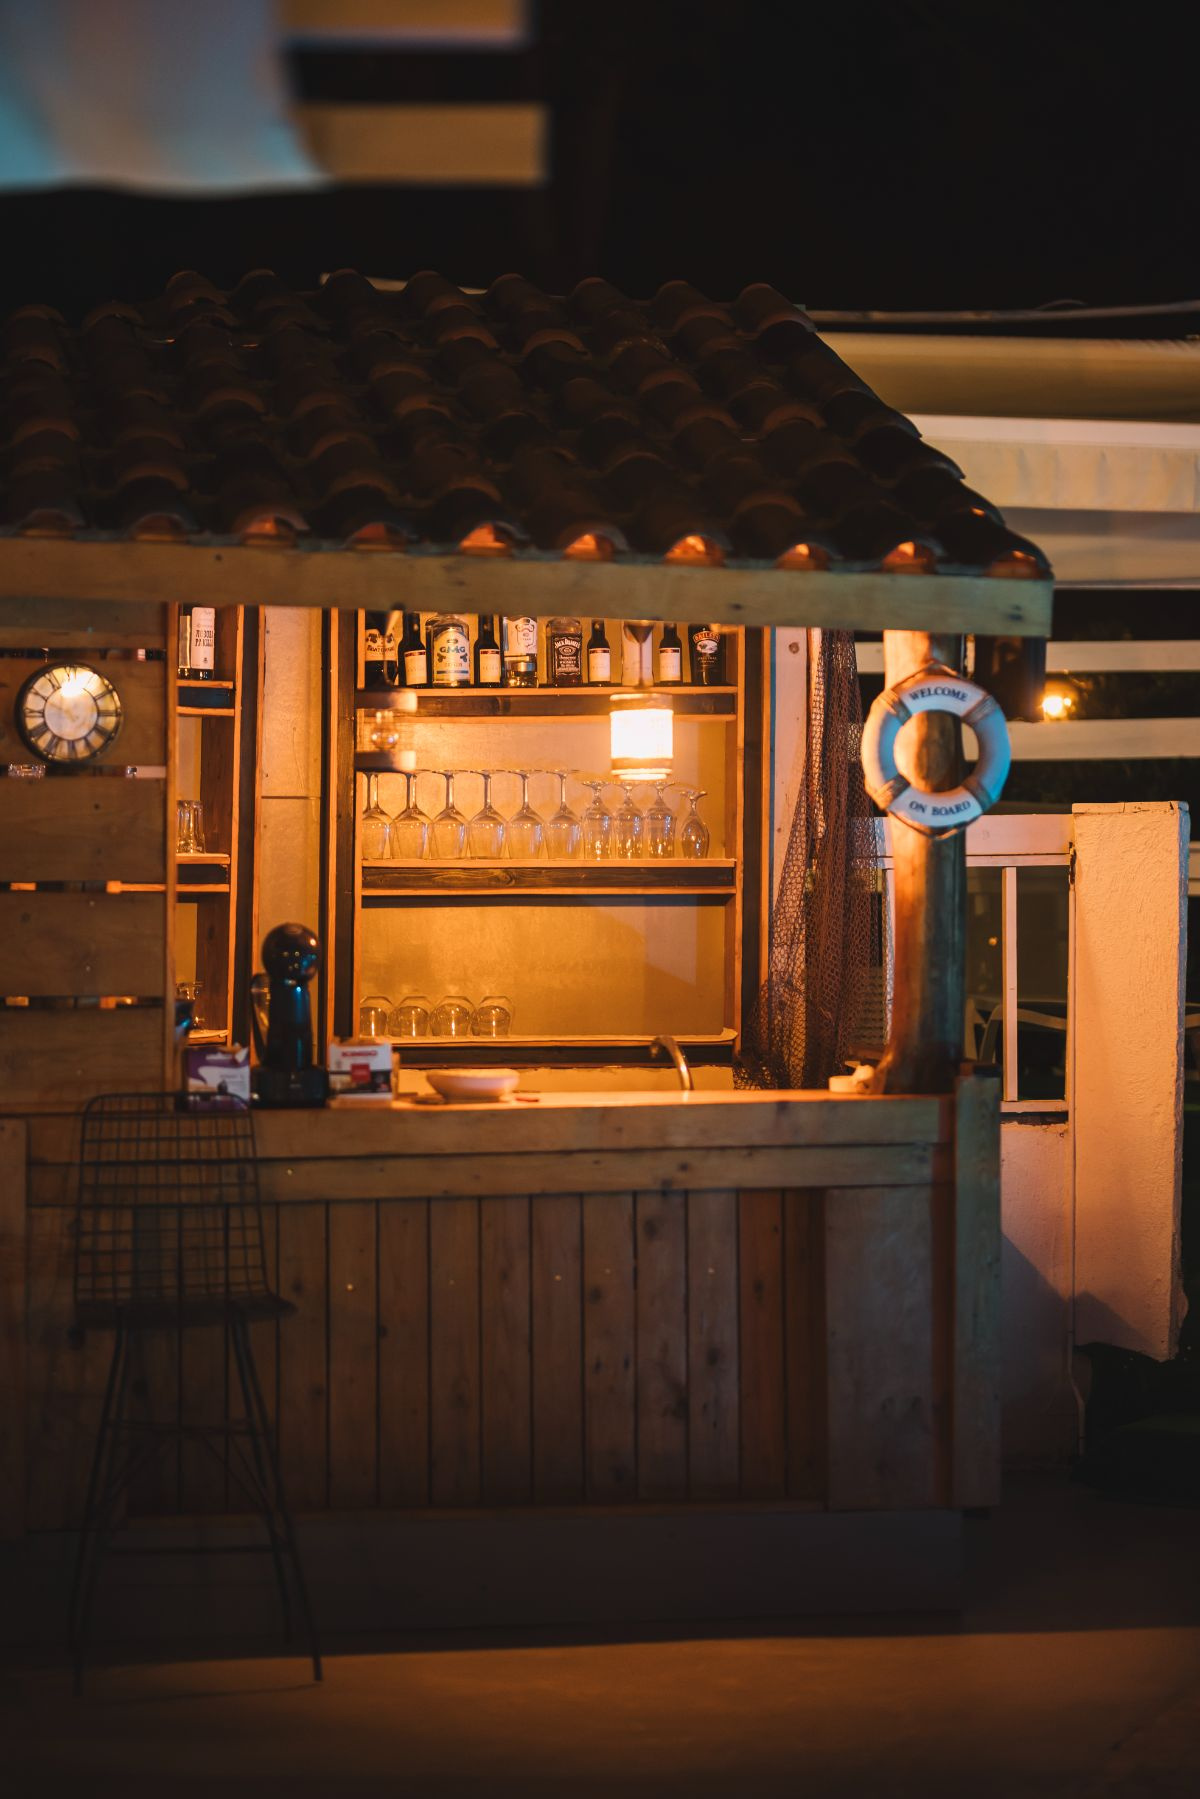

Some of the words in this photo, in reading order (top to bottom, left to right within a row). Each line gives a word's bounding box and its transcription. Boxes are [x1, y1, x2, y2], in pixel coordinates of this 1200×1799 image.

[909, 686, 968, 702] WELCOME
[909, 800, 926, 813] ON
[931, 801, 971, 816] BOARD
